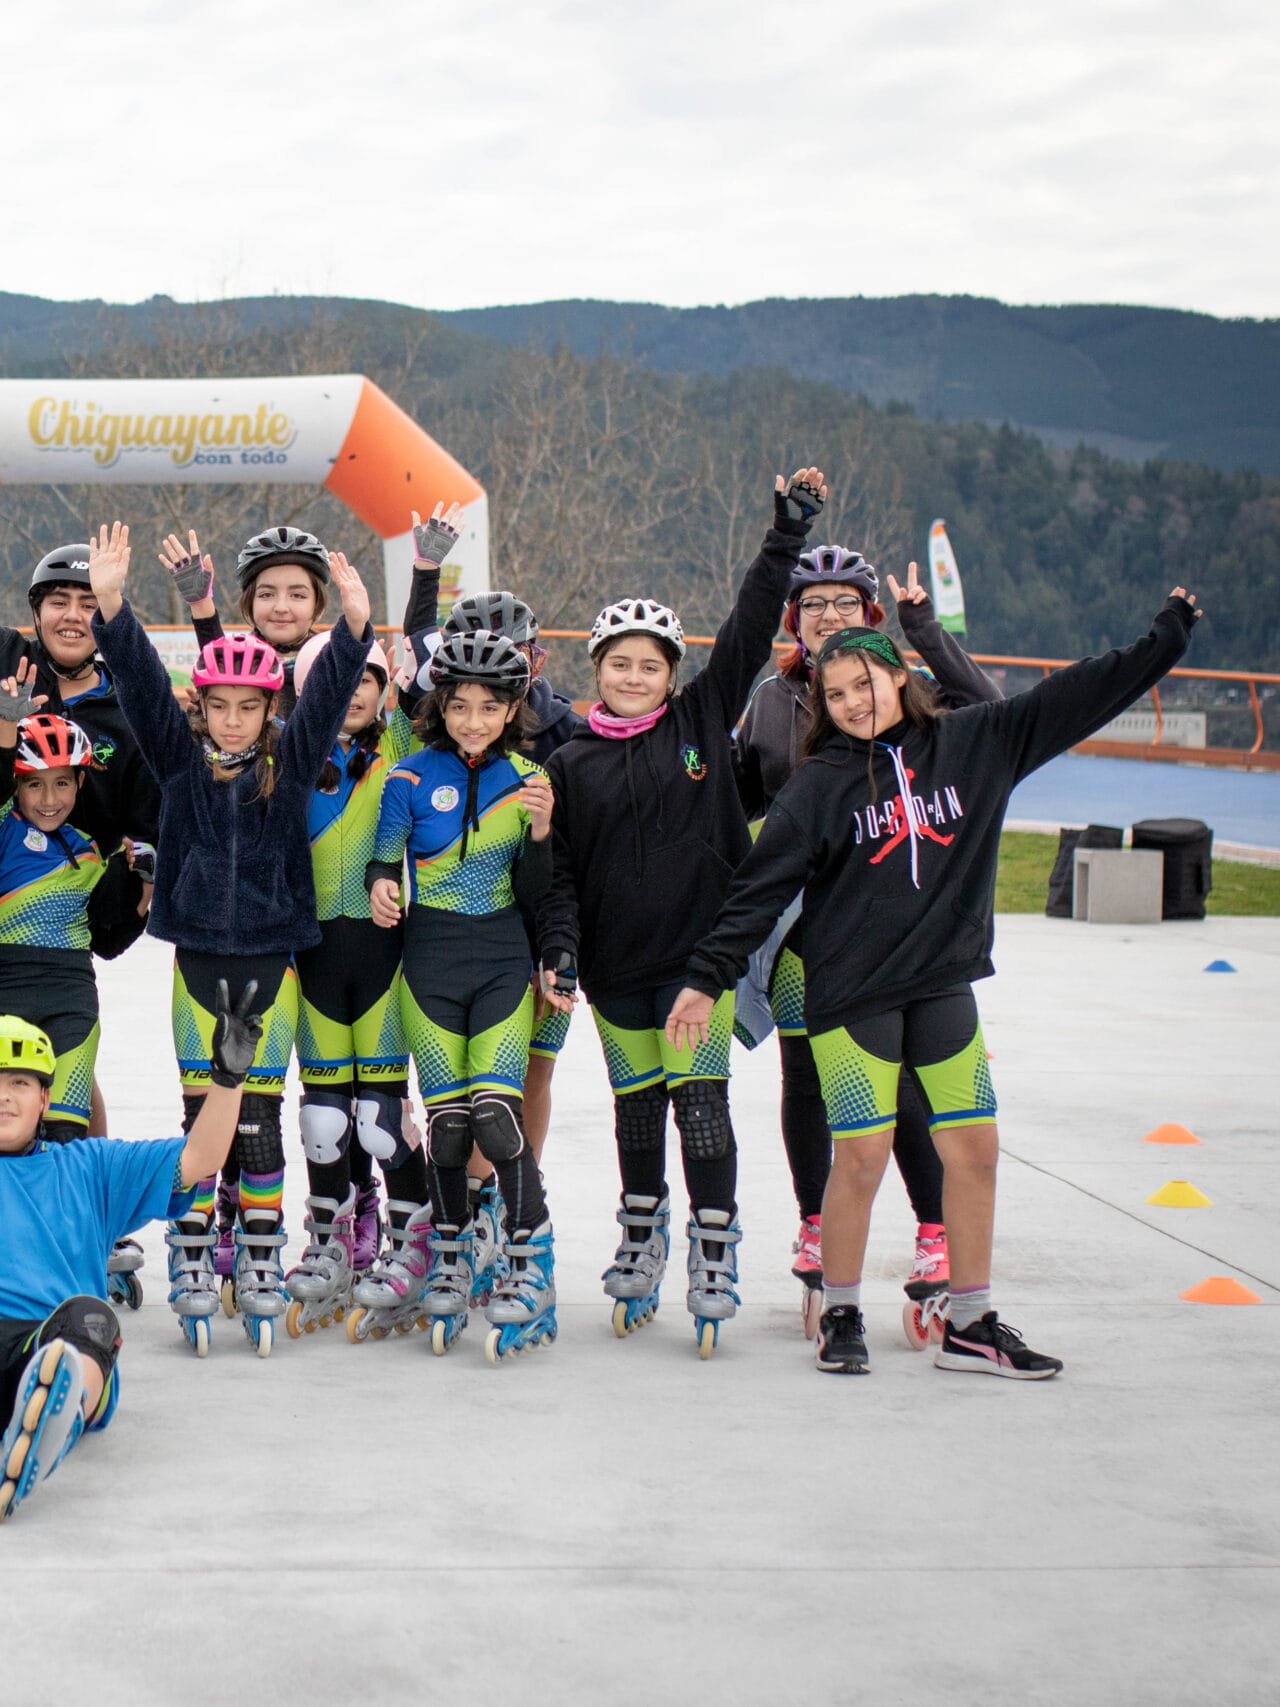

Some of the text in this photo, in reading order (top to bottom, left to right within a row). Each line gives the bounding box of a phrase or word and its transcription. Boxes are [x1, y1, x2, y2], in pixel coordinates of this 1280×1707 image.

[27, 397, 293, 464] Chiguayante
[194, 452, 288, 464] con todo
